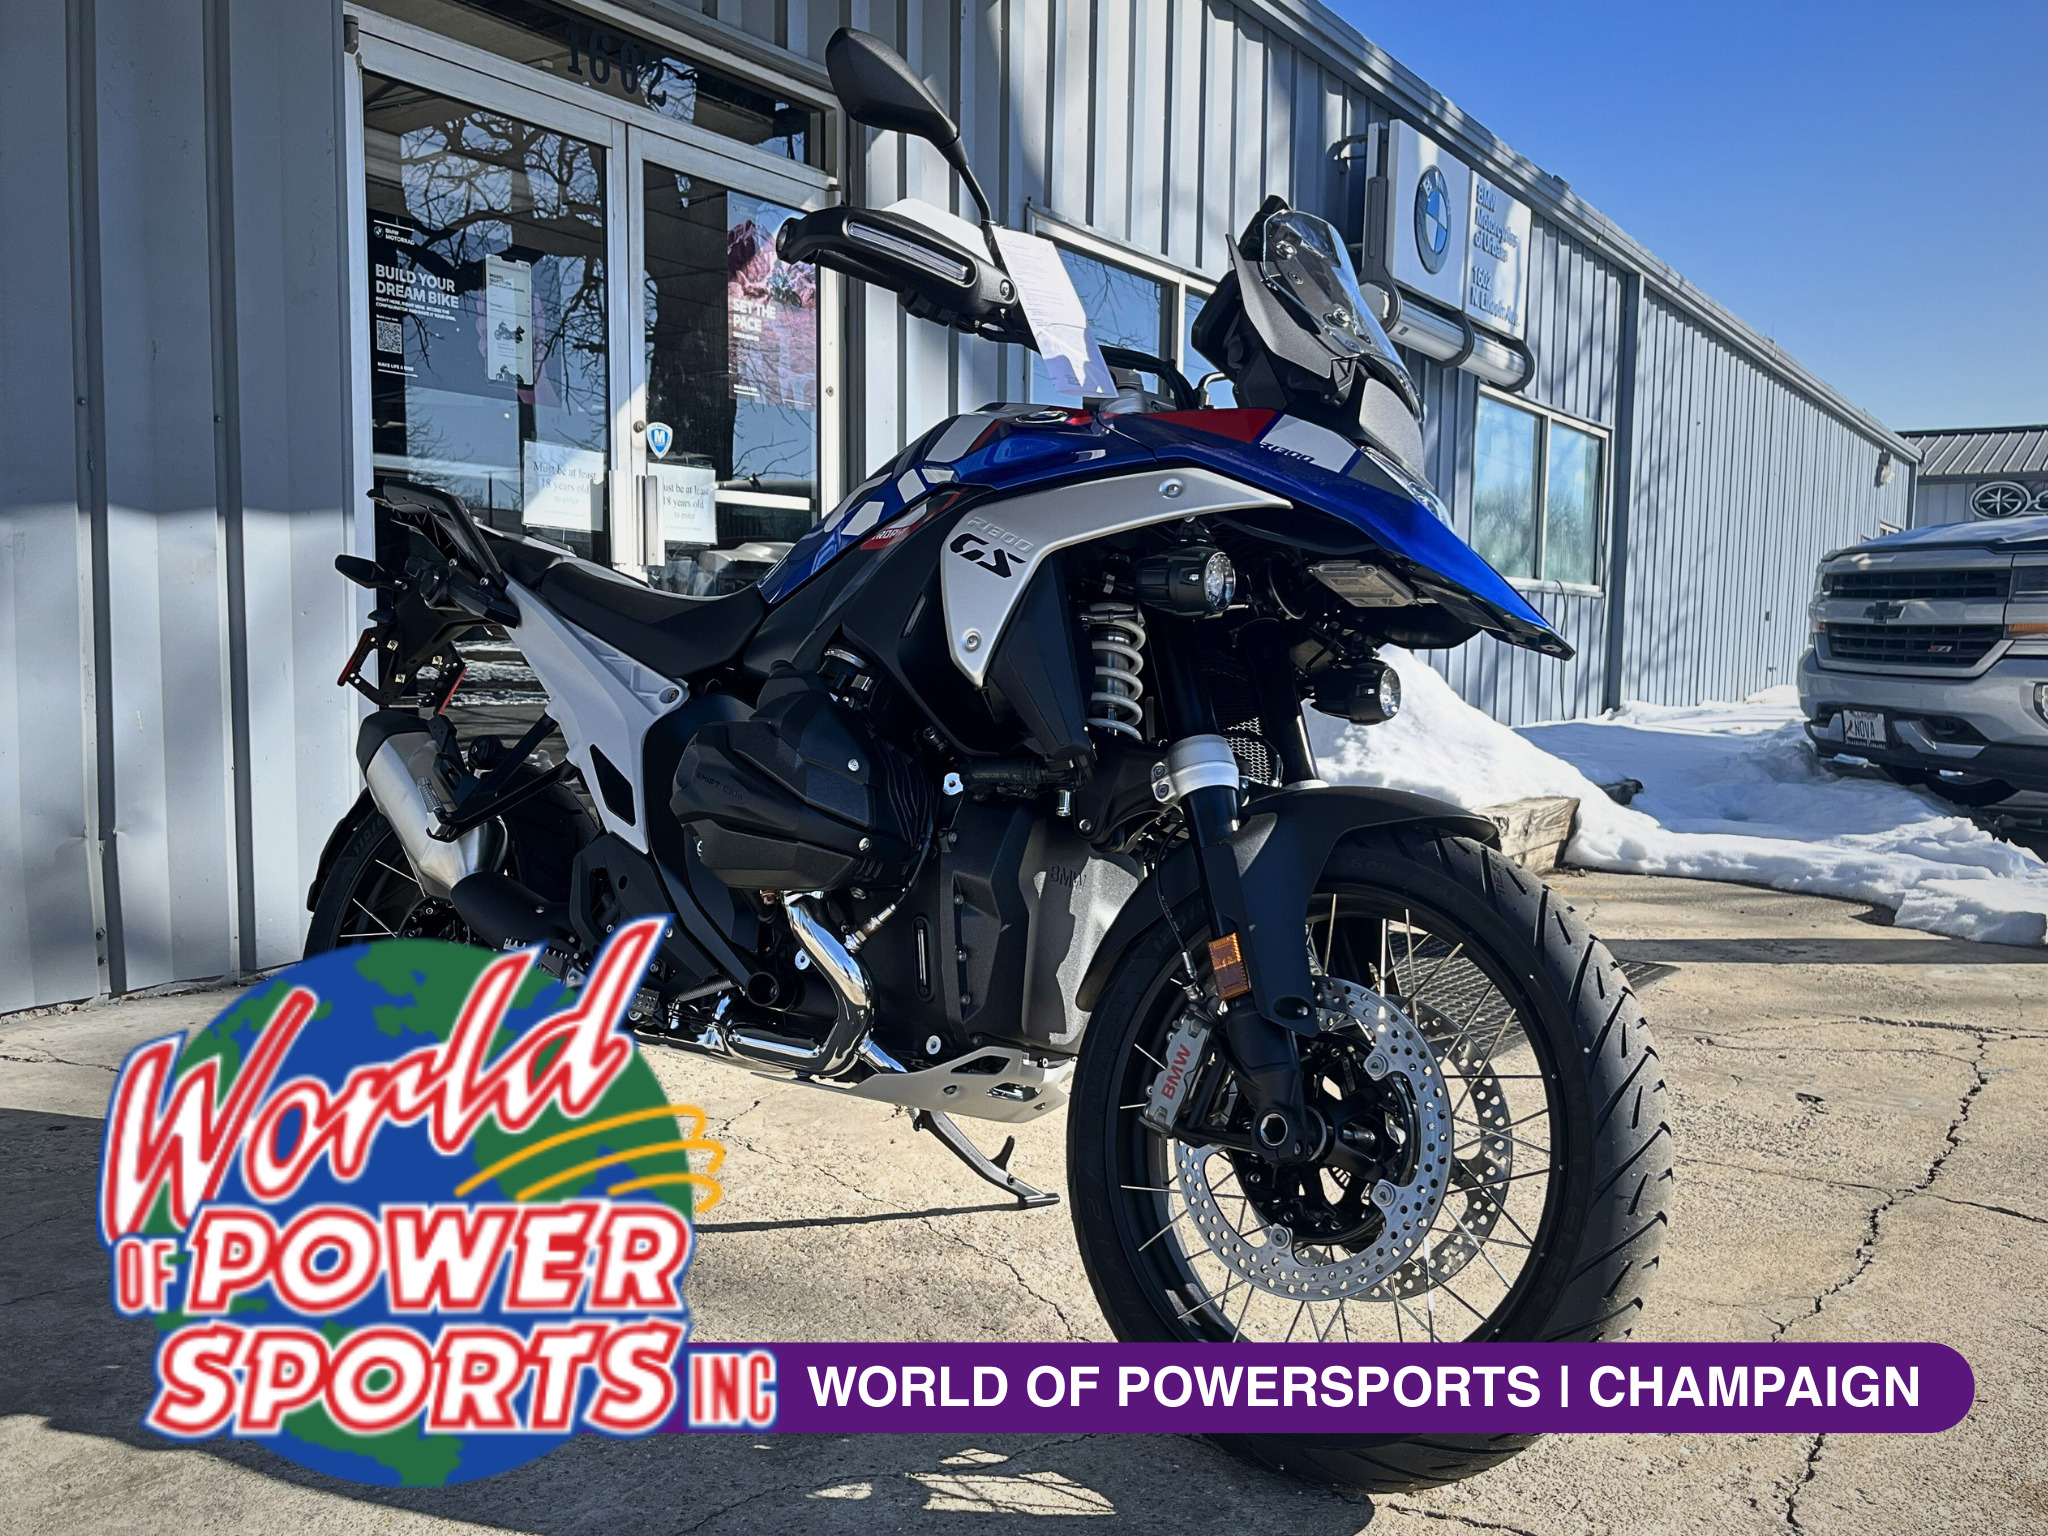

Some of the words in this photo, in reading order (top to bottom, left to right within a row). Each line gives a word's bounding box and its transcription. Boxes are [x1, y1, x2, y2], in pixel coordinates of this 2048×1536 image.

[565, 20, 667, 108] 1602
[1476, 184, 1498, 213] BMW
[385, 234, 415, 246] MOTORRAD
[375, 263, 416, 284] BUILD
[417, 272, 455, 293] YOUR
[1472, 265, 1492, 291] 1602
[376, 280, 426, 303] DREAM
[427, 290, 459, 309] BIKE
[733, 299, 755, 315] SET
[755, 304, 777, 319] THE
[733, 313, 762, 332] PACE
[533, 461, 555, 474] Must
[556, 465, 566, 476] be
[569, 468, 576, 478] at
[578, 470, 596, 481] least
[541, 477, 552, 488] 18
[552, 481, 576, 496] years
[576, 483, 589, 493] old
[675, 483, 685, 493] be
[685, 485, 693, 494] at
[694, 485, 709, 496] least
[673, 499, 692, 512] years
[692, 499, 704, 509] old
[950, 533, 1026, 579] GS
[1854, 719, 1876, 740] NOVA
[1161, 1043, 1192, 1100] BMW
